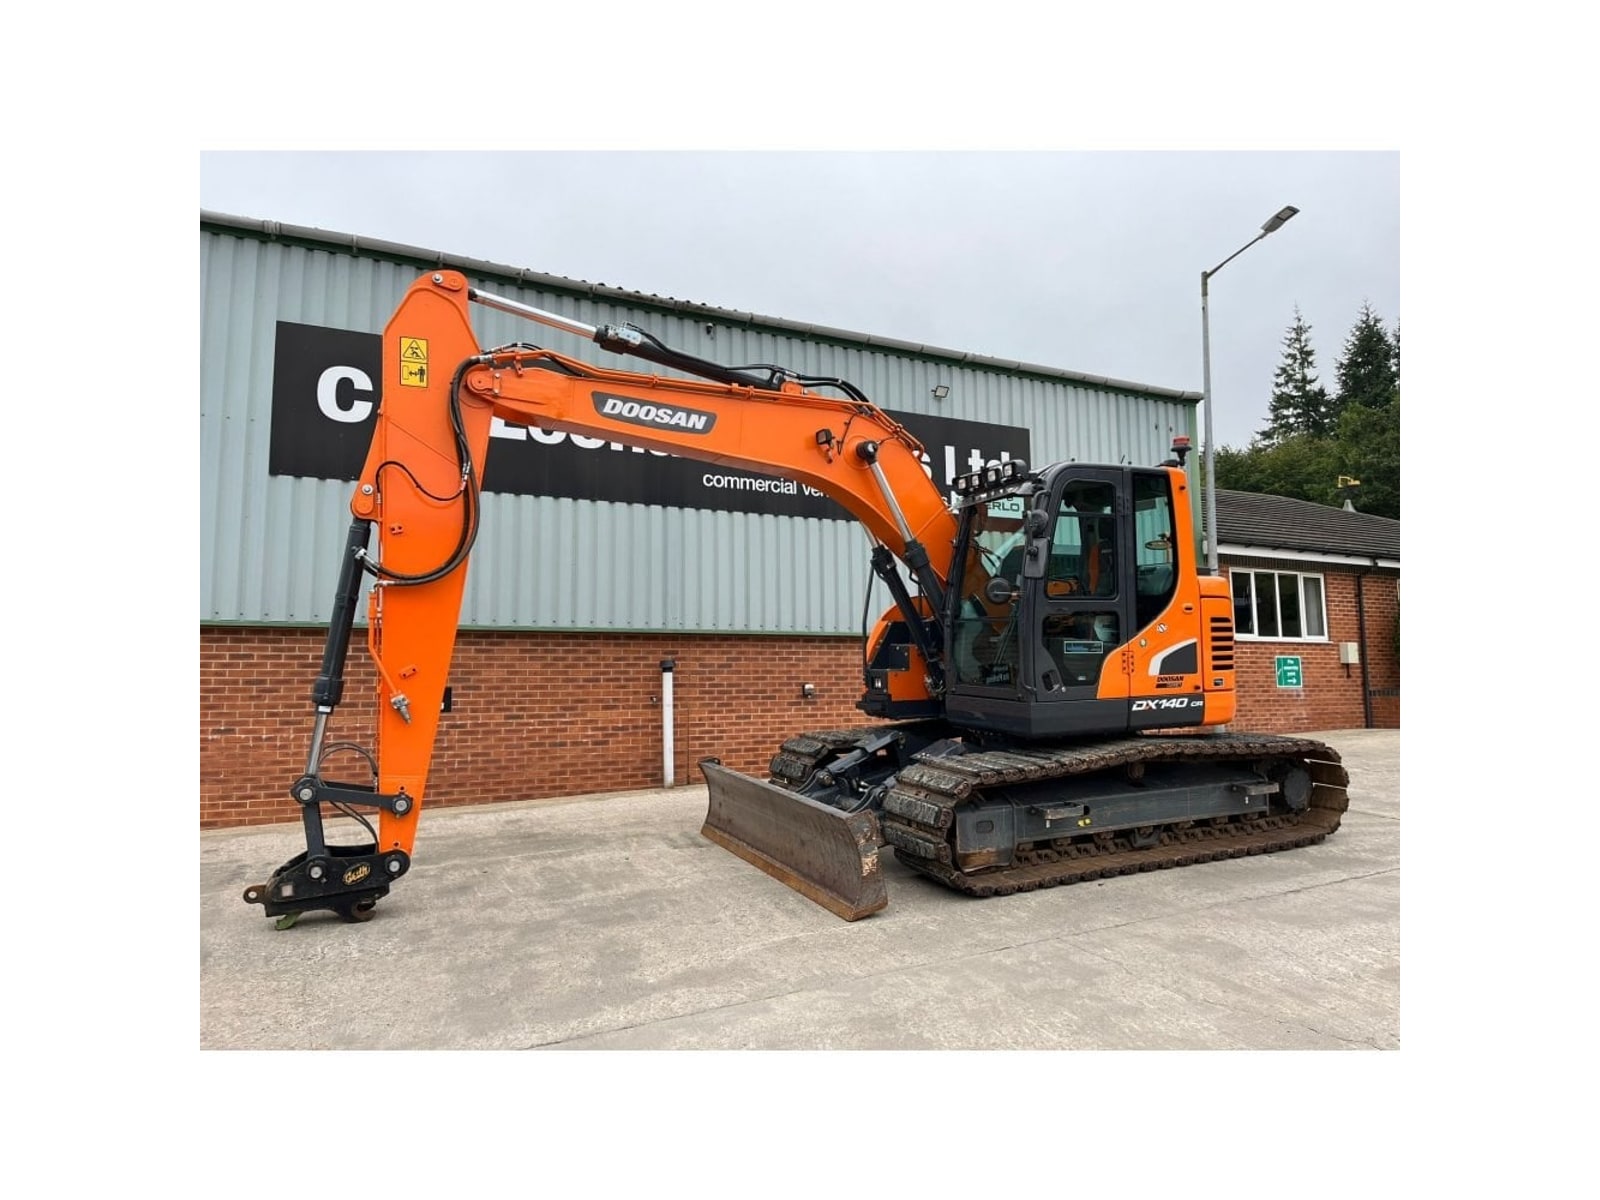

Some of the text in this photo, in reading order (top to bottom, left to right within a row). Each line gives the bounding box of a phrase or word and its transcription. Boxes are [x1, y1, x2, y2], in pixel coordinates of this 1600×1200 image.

[602, 398, 706, 430] DOOSAN
[702, 474, 797, 495] commercial
[1132, 698, 1188, 711] DX140
